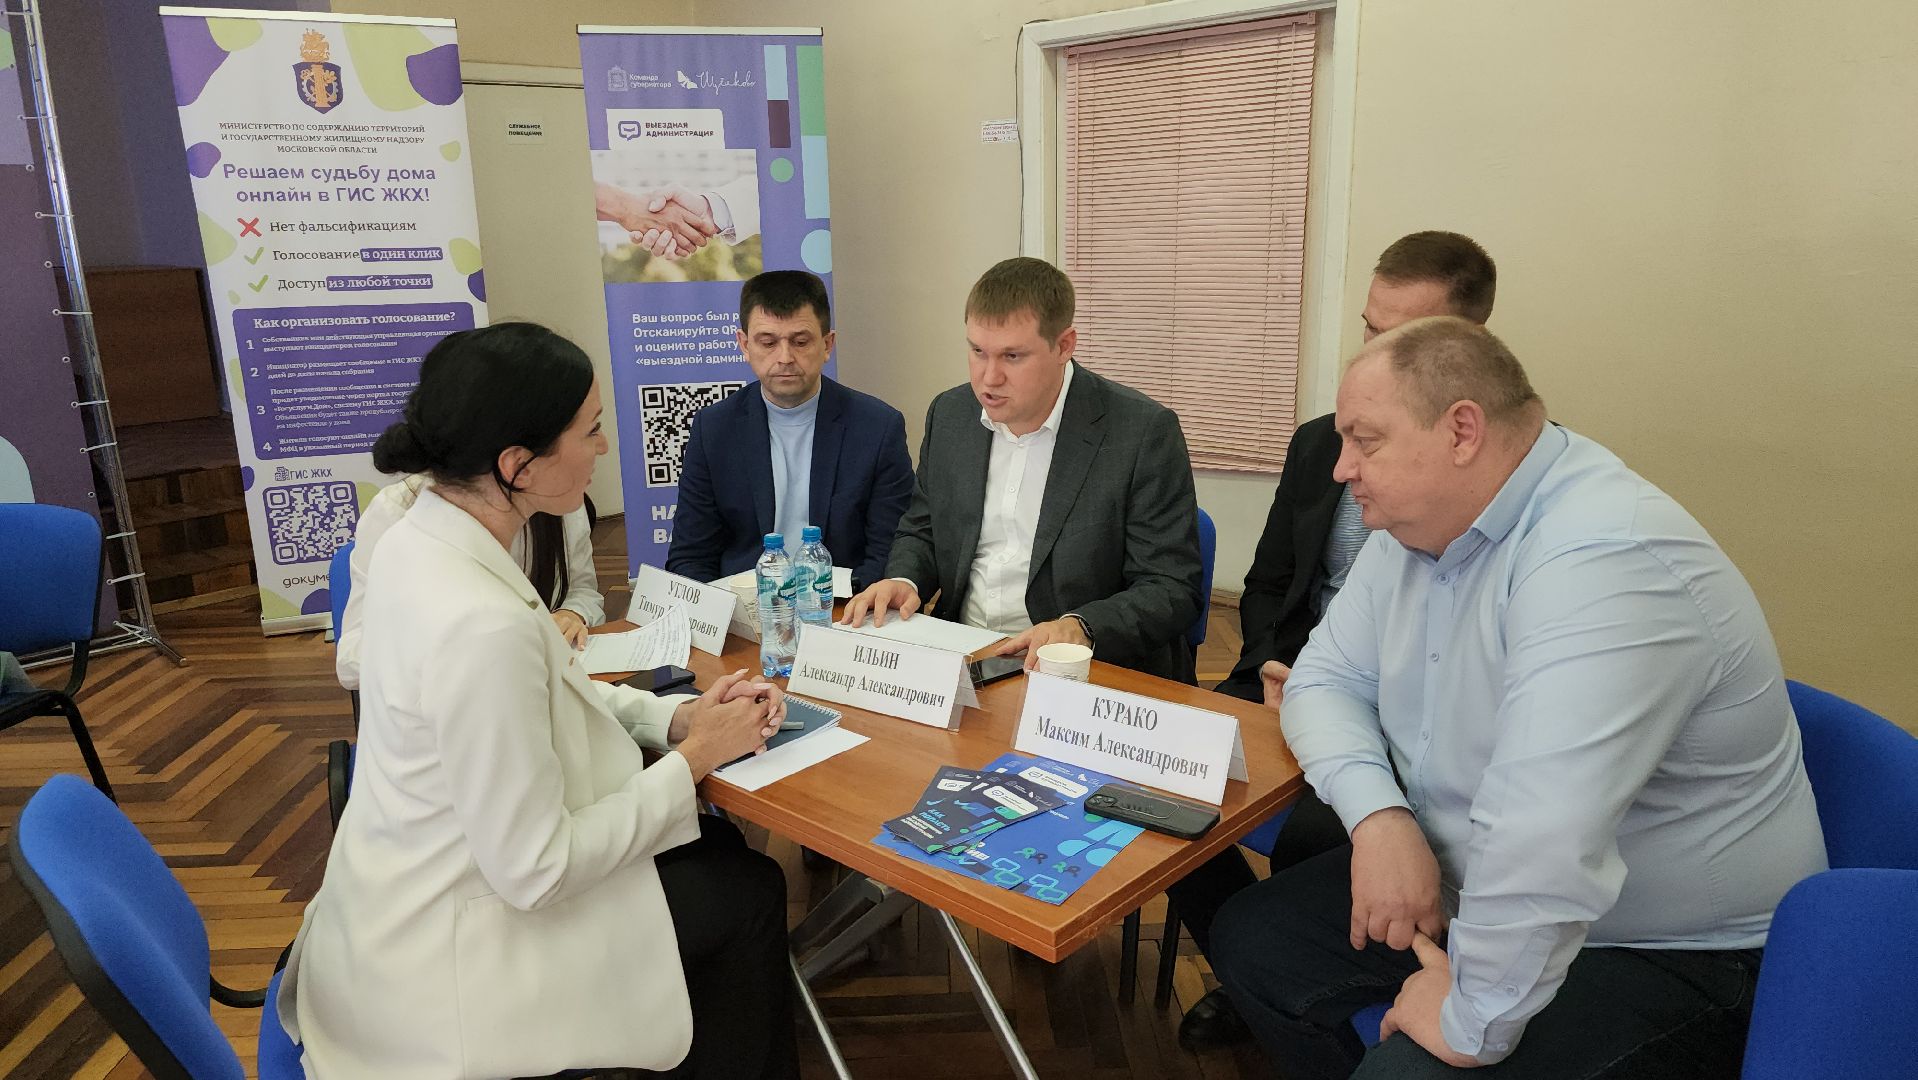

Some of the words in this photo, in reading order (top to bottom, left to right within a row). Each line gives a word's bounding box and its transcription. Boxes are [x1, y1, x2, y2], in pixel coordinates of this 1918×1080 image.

[219, 123, 291, 131] МИНИСТЕРСТВО
[292, 123, 305, 131] ПО
[306, 124, 370, 133] СОДЕРЖАНИЮ
[371, 124, 425, 133] ТЕРРИТОРИЙ
[646, 130, 714, 138] АДМИНИСТРАЦИЯ
[221, 133, 228, 141] И
[230, 134, 322, 142] ГОСУДАРСТВЕННОМУ
[324, 135, 385, 143] ЖИЛИЩНОМУ
[386, 136, 425, 144] НАДЗОРУ
[276, 145, 337, 153] МОСКОВСКОЙ
[338, 146, 378, 154] ОБЛАСТИ
[223, 163, 304, 179] Решаем
[311, 165, 380, 183] судьбу
[387, 168, 436, 182] дома
[236, 186, 311, 202] онлайн
[318, 191, 330, 202] в
[336, 187, 375, 202] ГИС
[381, 187, 430, 202] ЖКХ!
[270, 222, 295, 232] Нет
[299, 221, 417, 234] фальсификациям
[273, 250, 360, 261] Голосование
[373, 250, 406, 261] один
[408, 249, 442, 259] клик
[278, 279, 326, 291] Доступ
[328, 279, 345, 288] из
[347, 276, 391, 288] любой
[393, 277, 432, 288] точки
[253, 318, 280, 329] Как
[281, 316, 370, 329] организовать
[371, 312, 456, 324] голосование?
[632, 313, 658, 323] Ваш
[660, 313, 703, 324] вопрос
[706, 311, 729, 321] был
[633, 326, 719, 338] Отсканируйте
[246, 340, 255, 349] 1
[634, 344, 643, 352] и
[645, 342, 696, 352] оцените
[698, 339, 738, 352] работу
[636, 354, 703, 366] «выездной
[250, 367, 259, 377] 2
[256, 405, 265, 415] 3
[263, 441, 272, 451] 4
[290, 470, 308, 480] ГИС
[310, 468, 333, 478] ЖКХ
[668, 580, 701, 605] УГЛОВ
[639, 594, 665, 620] Тимур
[853, 644, 900, 670] ИЛЬИН
[799, 661, 856, 692] Александр
[857, 674, 945, 708] Александрович
[1091, 697, 1158, 731] КУРАКО
[1035, 715, 1090, 749] Максим
[1093, 731, 1208, 780] Александрович
